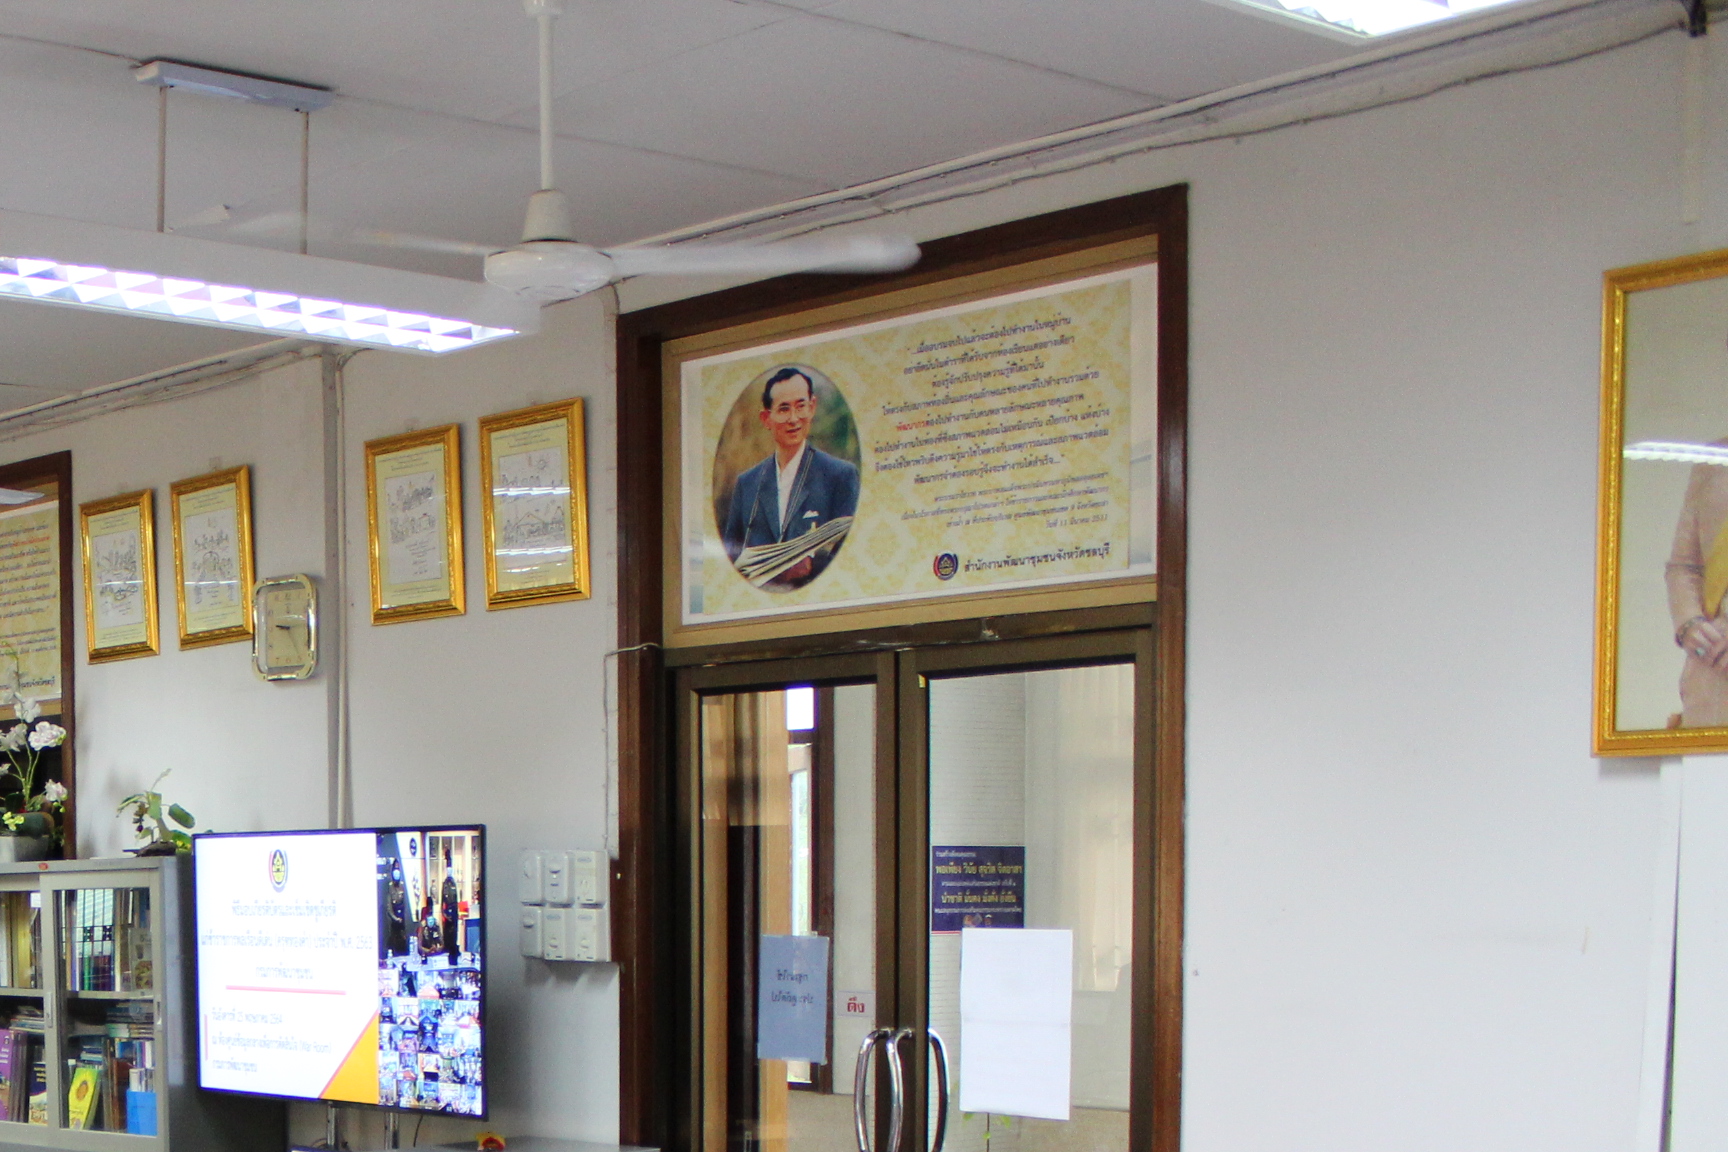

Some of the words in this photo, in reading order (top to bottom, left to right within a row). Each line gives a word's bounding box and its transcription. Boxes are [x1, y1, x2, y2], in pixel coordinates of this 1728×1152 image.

[964, 543, 1111, 573] สำนักงานพัฒนาชุมชนจังหวัดชลบุรี
[355, 935, 373, 950] 2563
[847, 996, 865, 1013] ดึง
